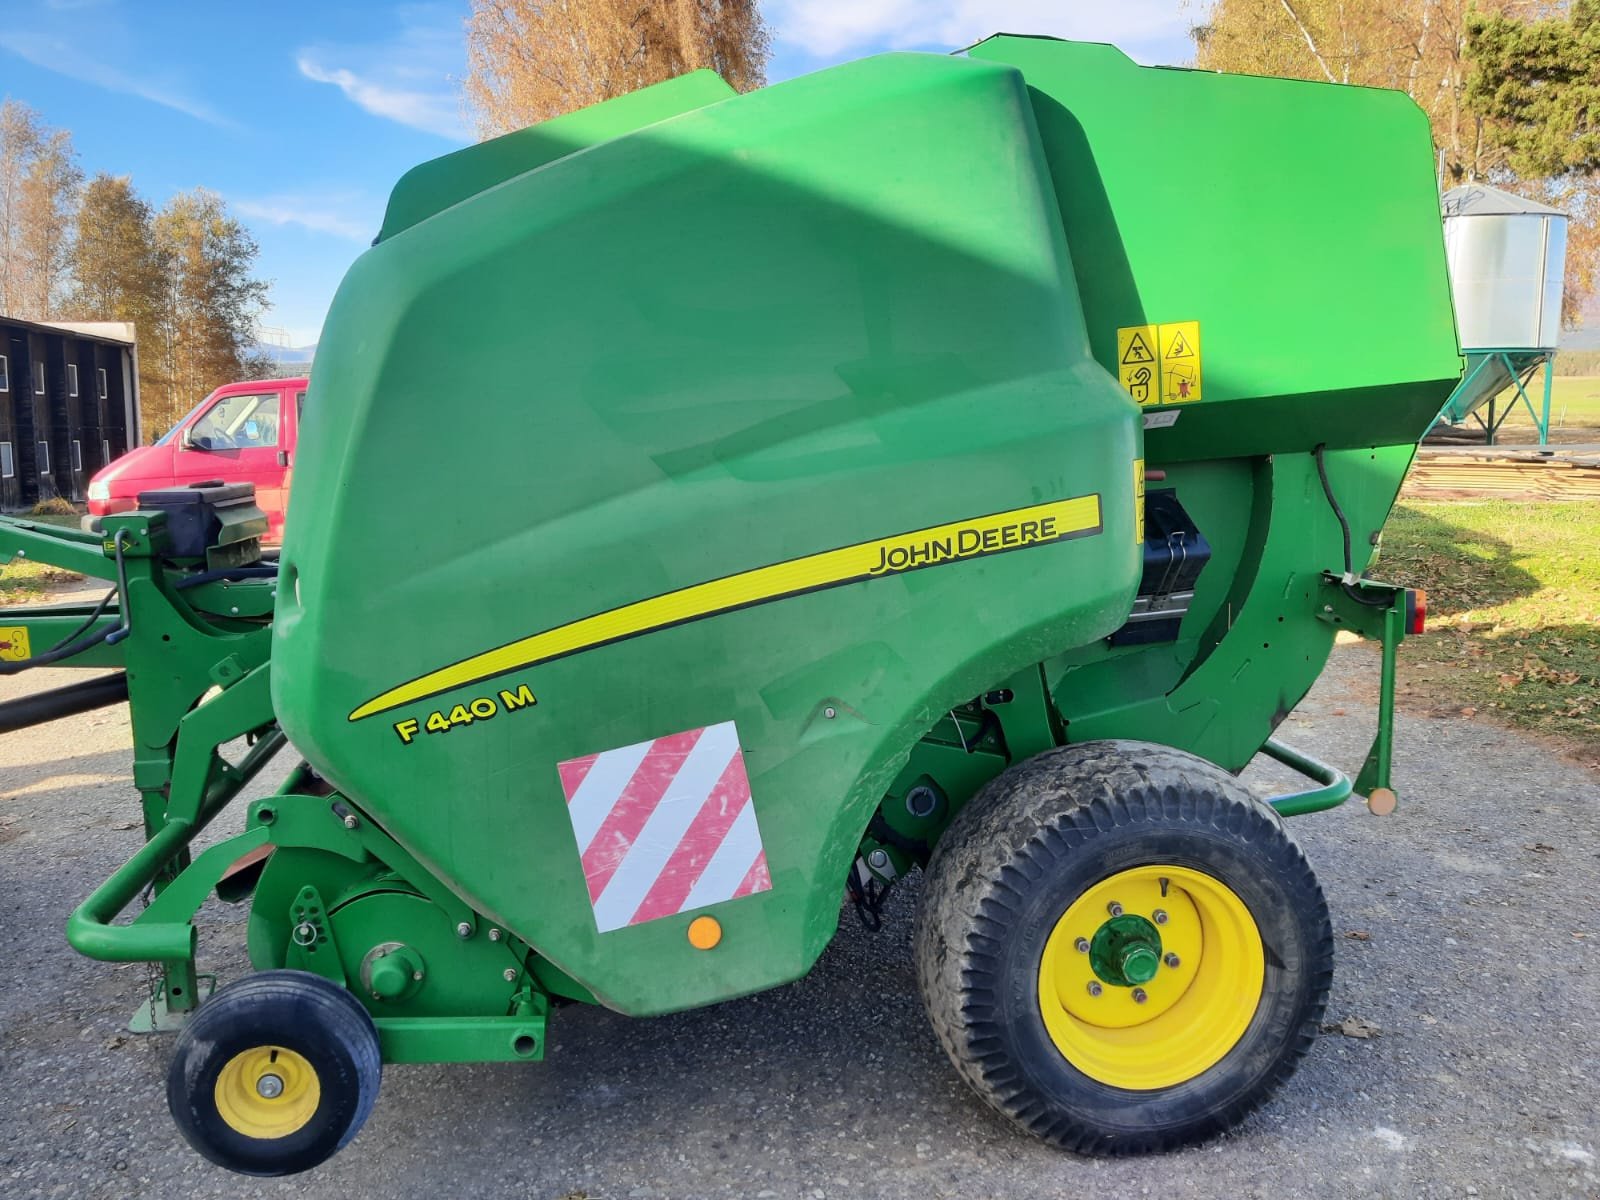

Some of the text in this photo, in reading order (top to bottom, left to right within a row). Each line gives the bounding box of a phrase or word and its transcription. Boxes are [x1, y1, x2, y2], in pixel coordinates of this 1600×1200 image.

[869, 517, 1057, 573] JOHN DEERE
[394, 683, 537, 745] F 440 M
